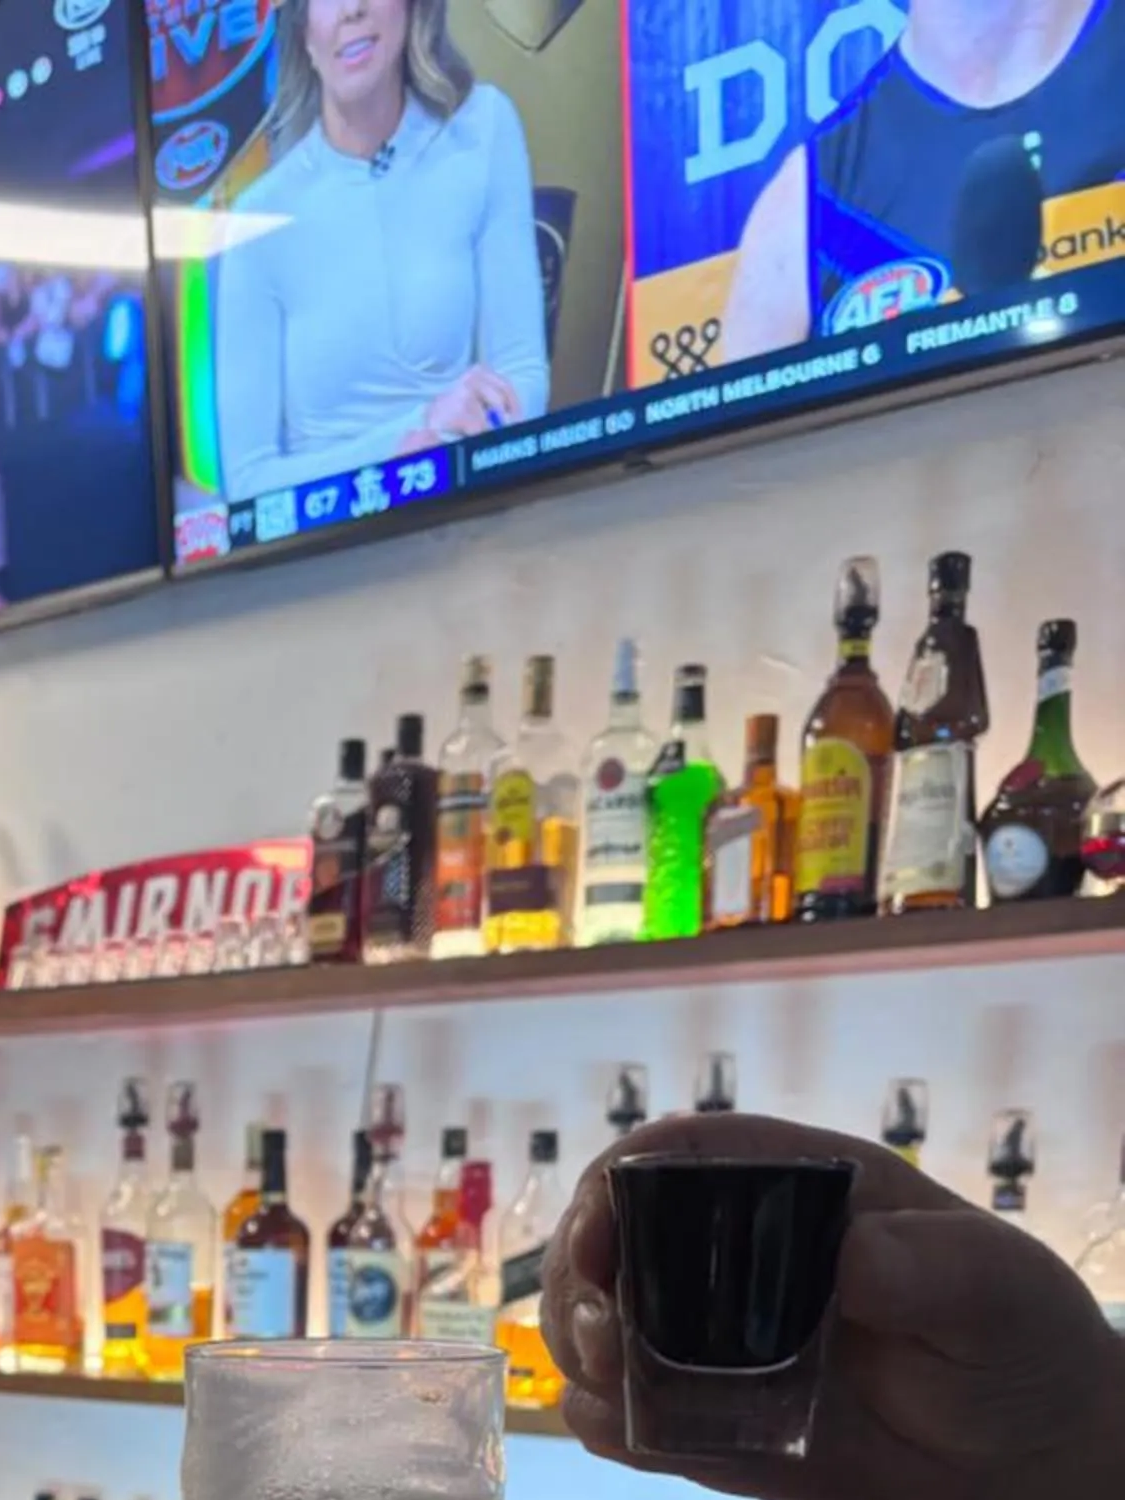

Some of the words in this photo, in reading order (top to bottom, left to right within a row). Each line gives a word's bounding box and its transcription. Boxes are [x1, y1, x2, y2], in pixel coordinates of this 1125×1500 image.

[150, 0, 261, 82] IVE
[1038, 217, 1125, 264] ank
[832, 268, 933, 334] AFL
[645, 390, 720, 424] NORTH
[722, 348, 859, 404] MELBOURNE
[906, 299, 1053, 354] FREMANTLE
[304, 487, 339, 519] 67
[396, 459, 436, 495] 73
[21, 867, 312, 952] SMIRNOF
